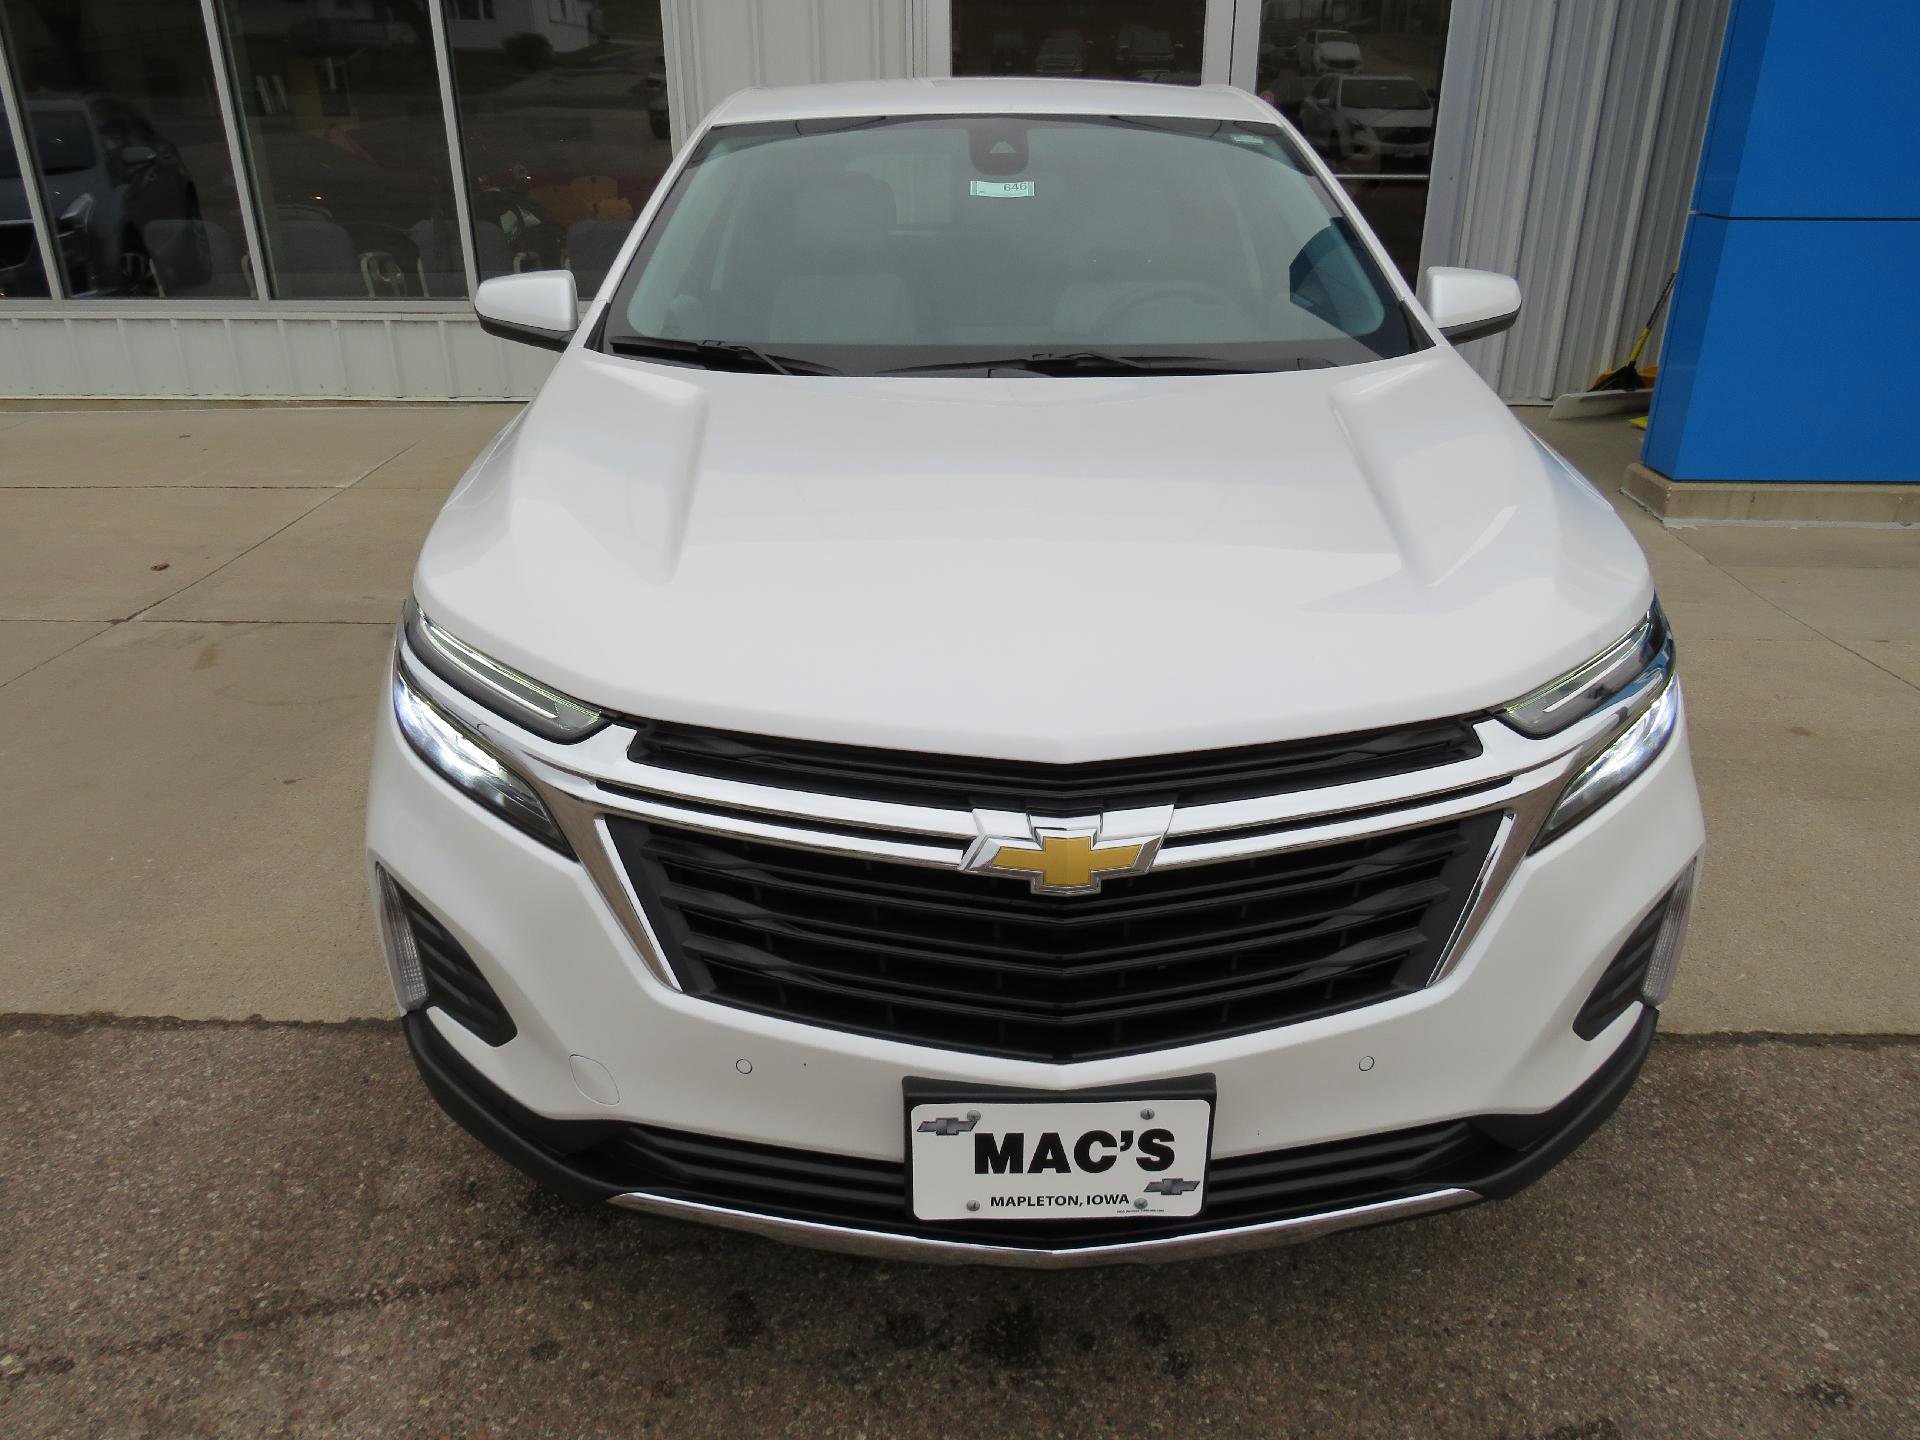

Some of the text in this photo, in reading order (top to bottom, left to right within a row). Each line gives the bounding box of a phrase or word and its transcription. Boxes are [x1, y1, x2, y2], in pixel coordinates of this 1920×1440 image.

[1003, 182, 1027, 192] 646
[974, 1128, 1175, 1174] MAC'S
[990, 1194, 1130, 1208] MAPLETON, IOWA
